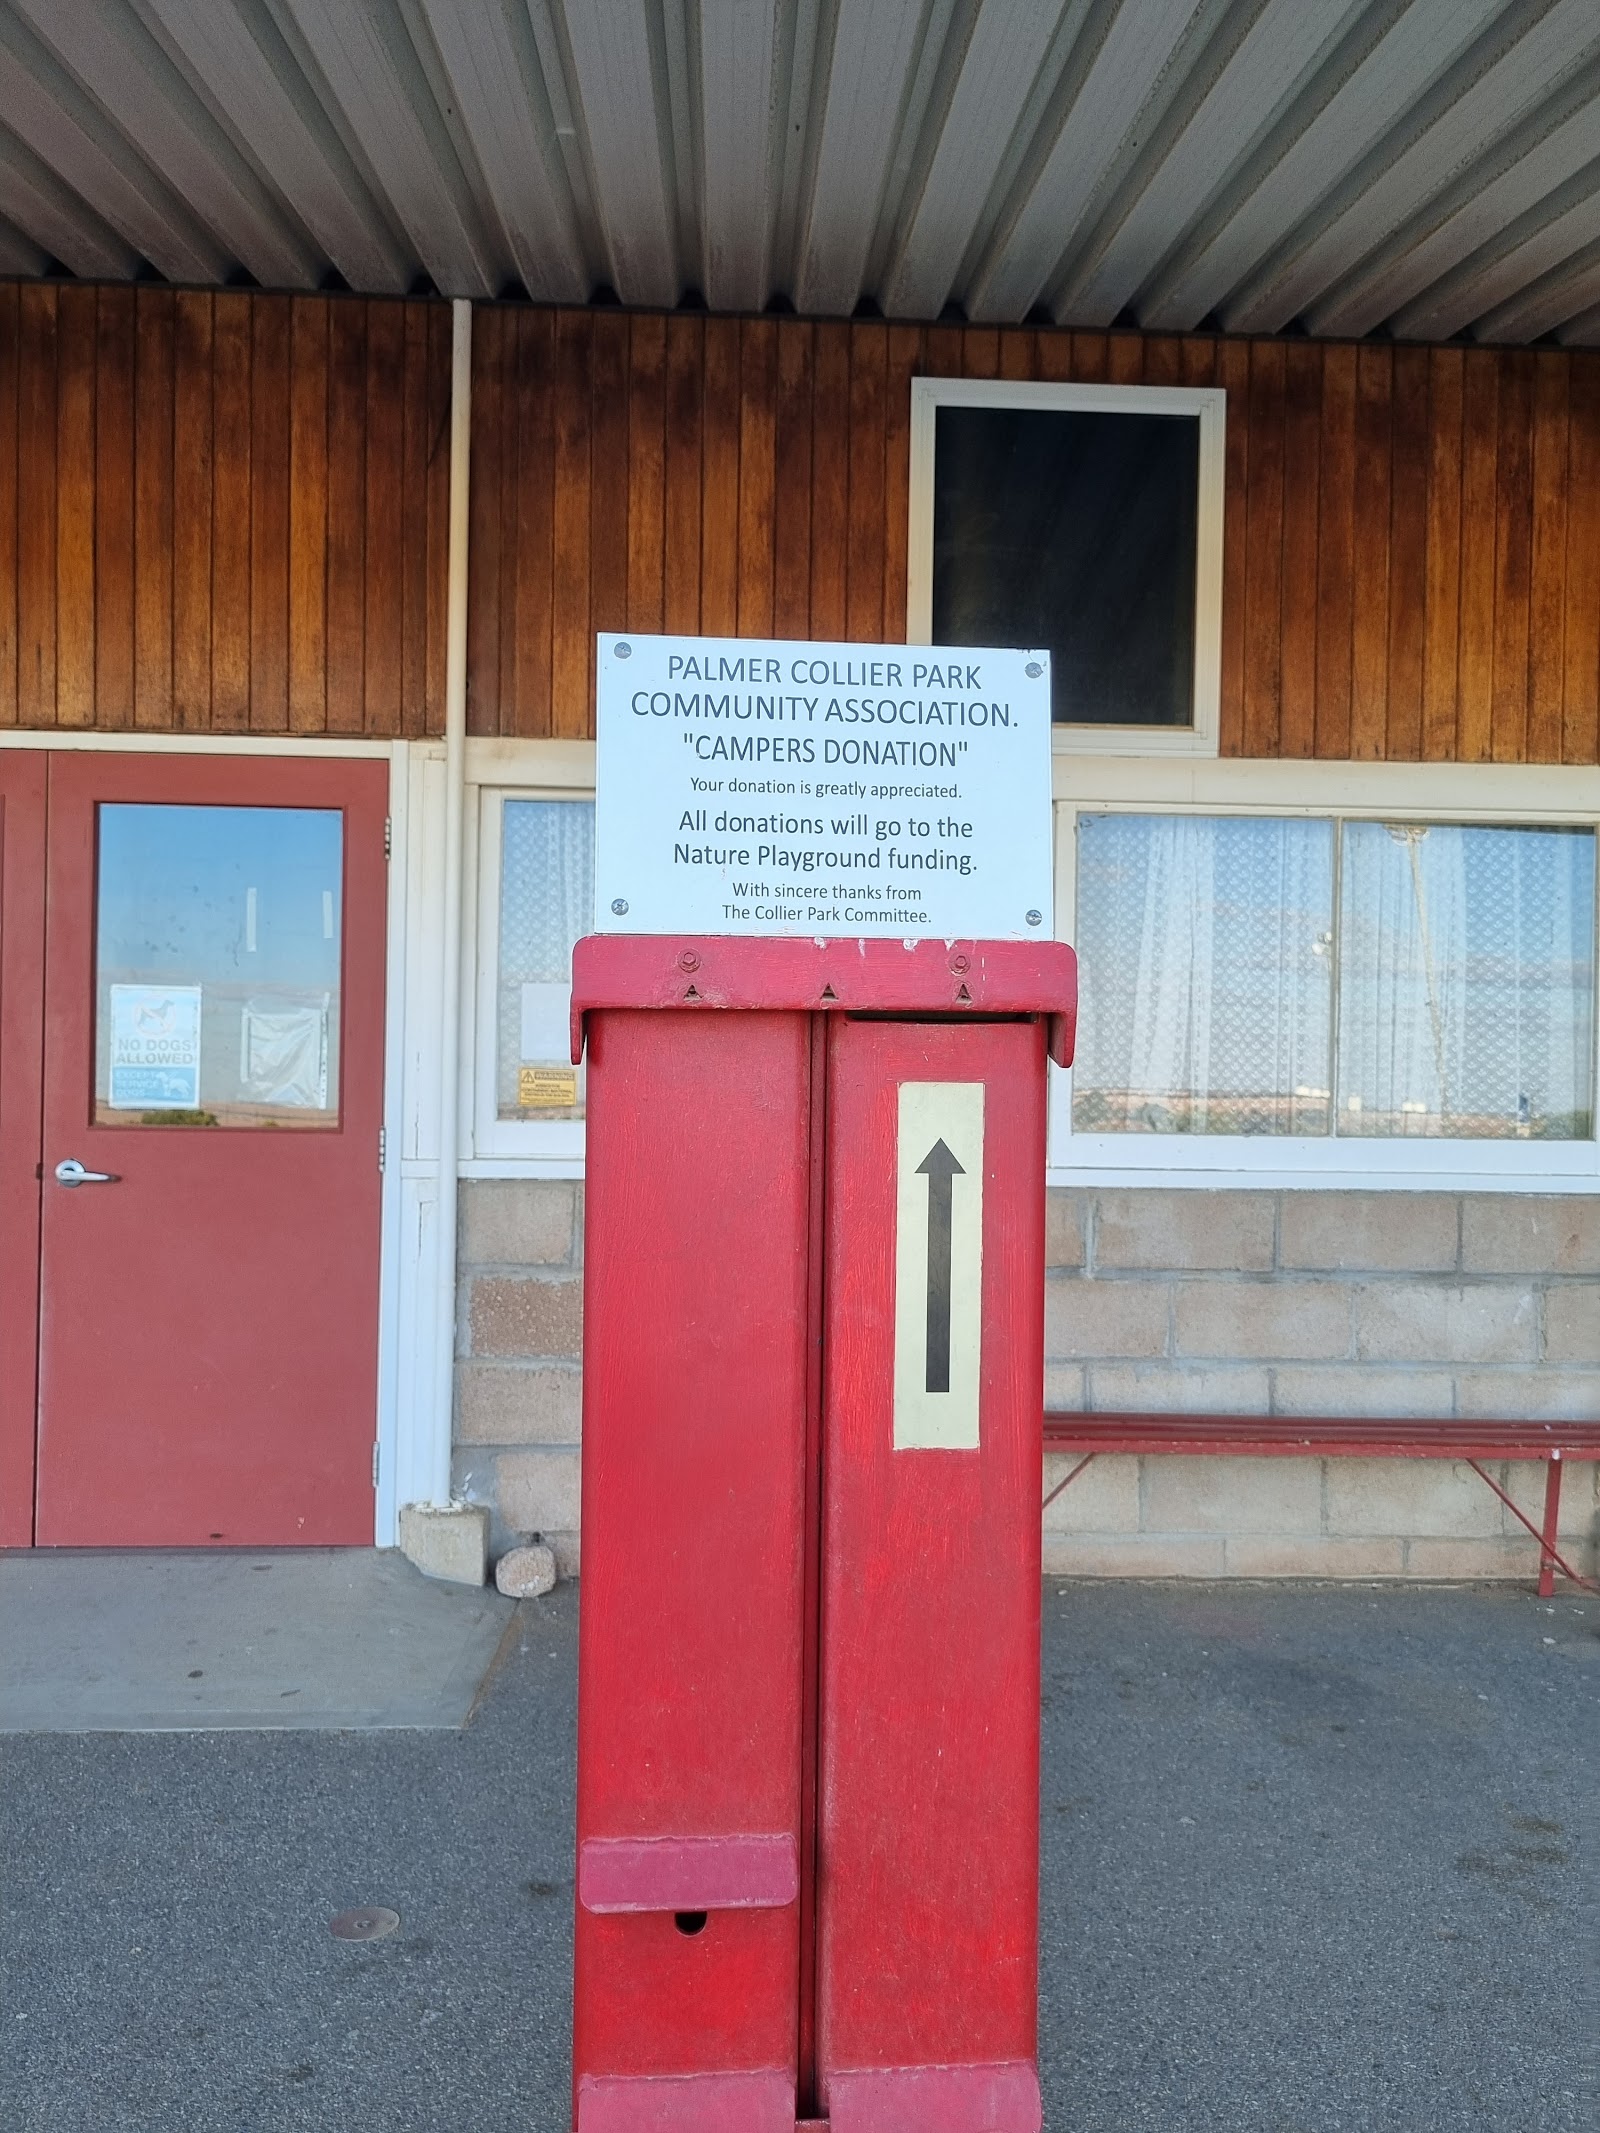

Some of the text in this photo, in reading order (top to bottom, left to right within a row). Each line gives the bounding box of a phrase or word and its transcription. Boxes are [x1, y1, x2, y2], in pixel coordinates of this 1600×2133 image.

[668, 656, 981, 689] PALMER COLLIER PARK
[631, 692, 1018, 727] COMMUNITY ASSOCIATION.
[683, 733, 968, 766] "CAMPERS DONATION"
[690, 777, 962, 799] Your donation is greatly appreciated.
[679, 810, 973, 840] All donations will go to the
[674, 844, 977, 875] Nature Playground funding.
[732, 882, 921, 900] With sincere thanks from
[722, 905, 931, 923] The Collier Park Committee.
[116, 1052, 193, 1064] ALLOWED
[118, 1039, 192, 1051] NO DOGS
